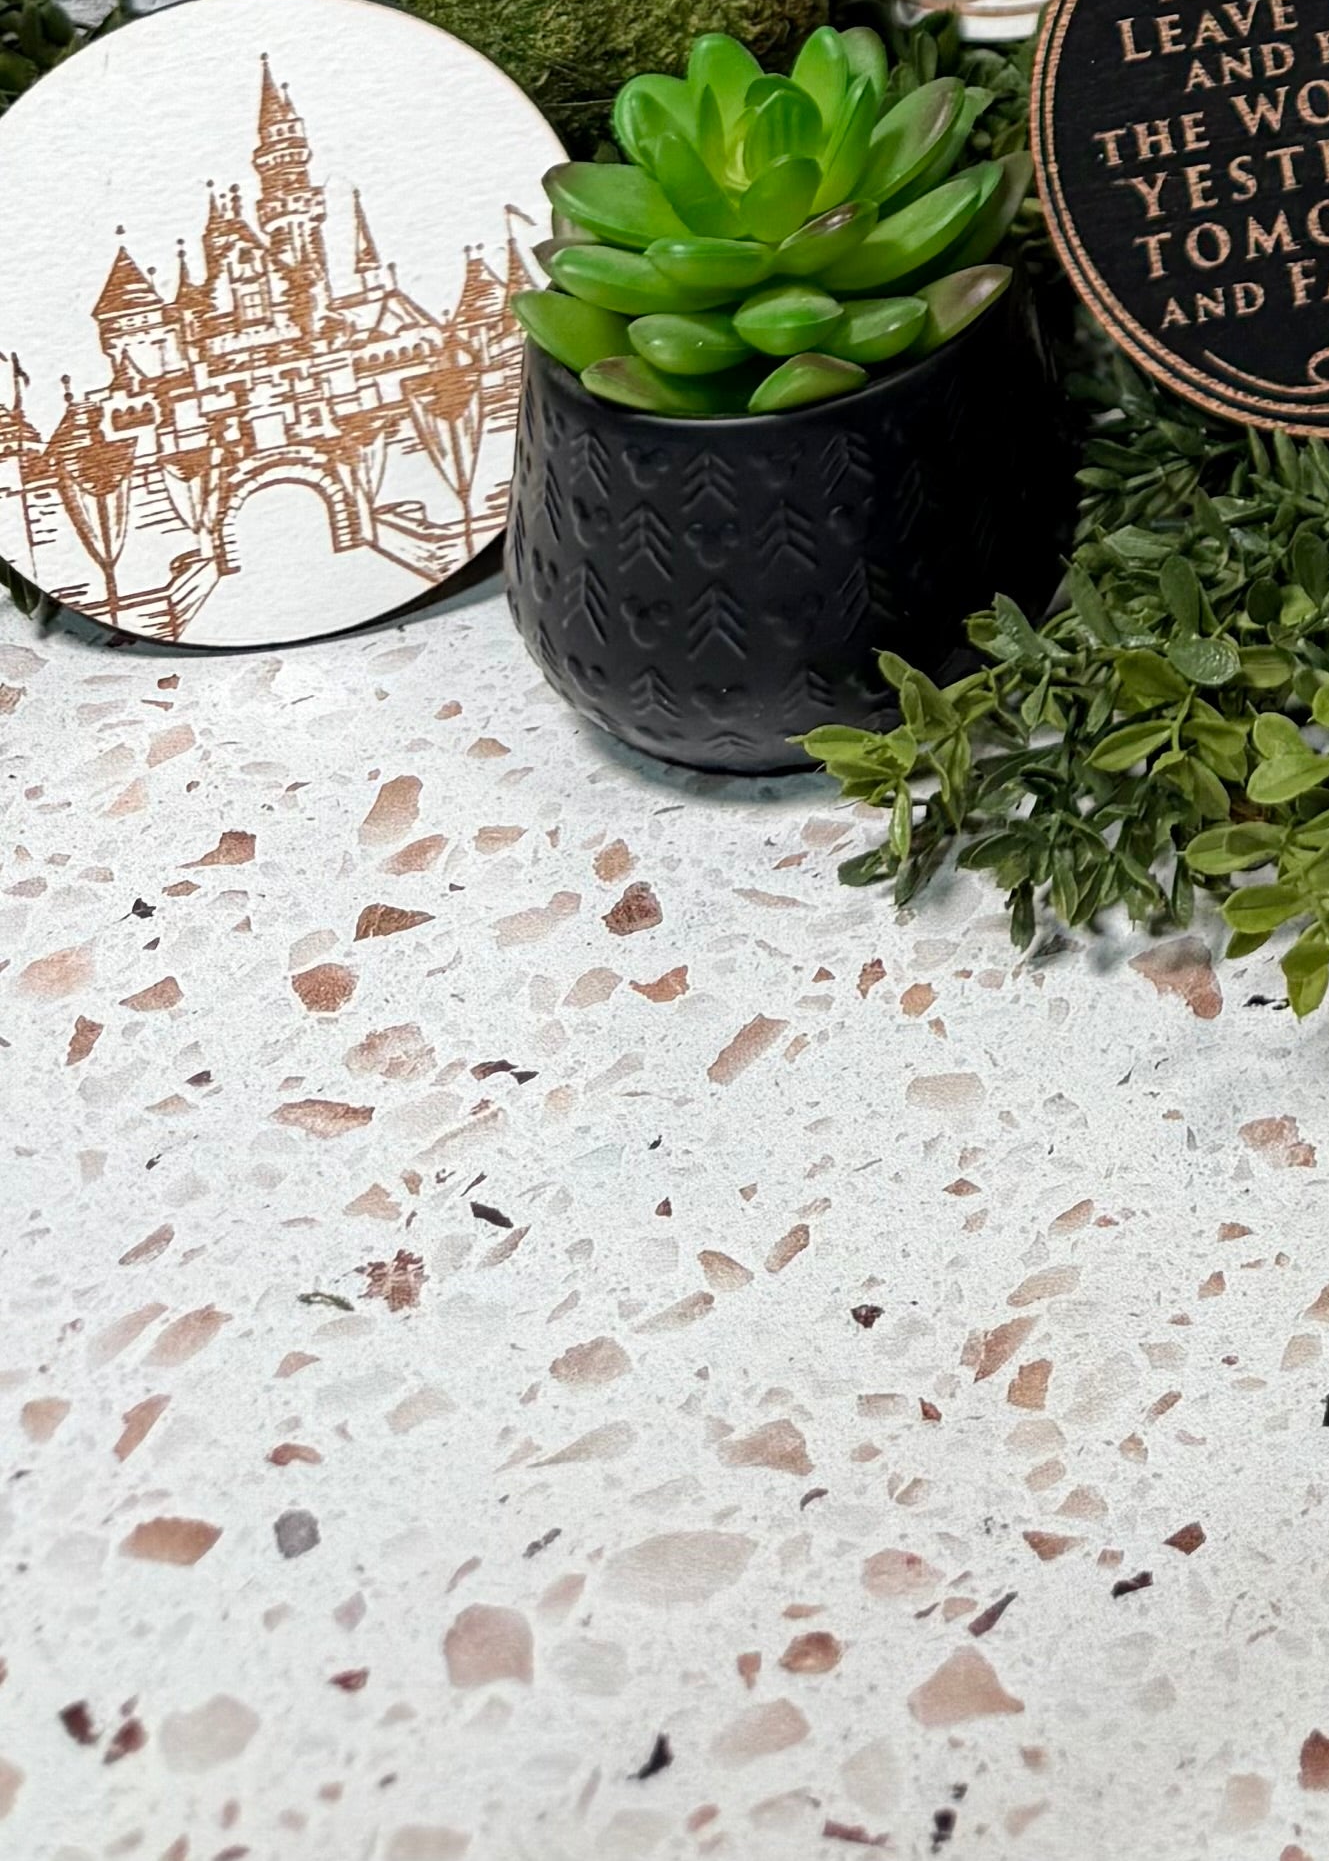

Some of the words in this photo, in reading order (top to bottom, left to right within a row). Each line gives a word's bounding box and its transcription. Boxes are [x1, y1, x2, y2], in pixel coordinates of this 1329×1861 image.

[1184, 41, 1295, 93] AND
[1094, 111, 1210, 167] THE
[1160, 282, 1265, 329] AND
